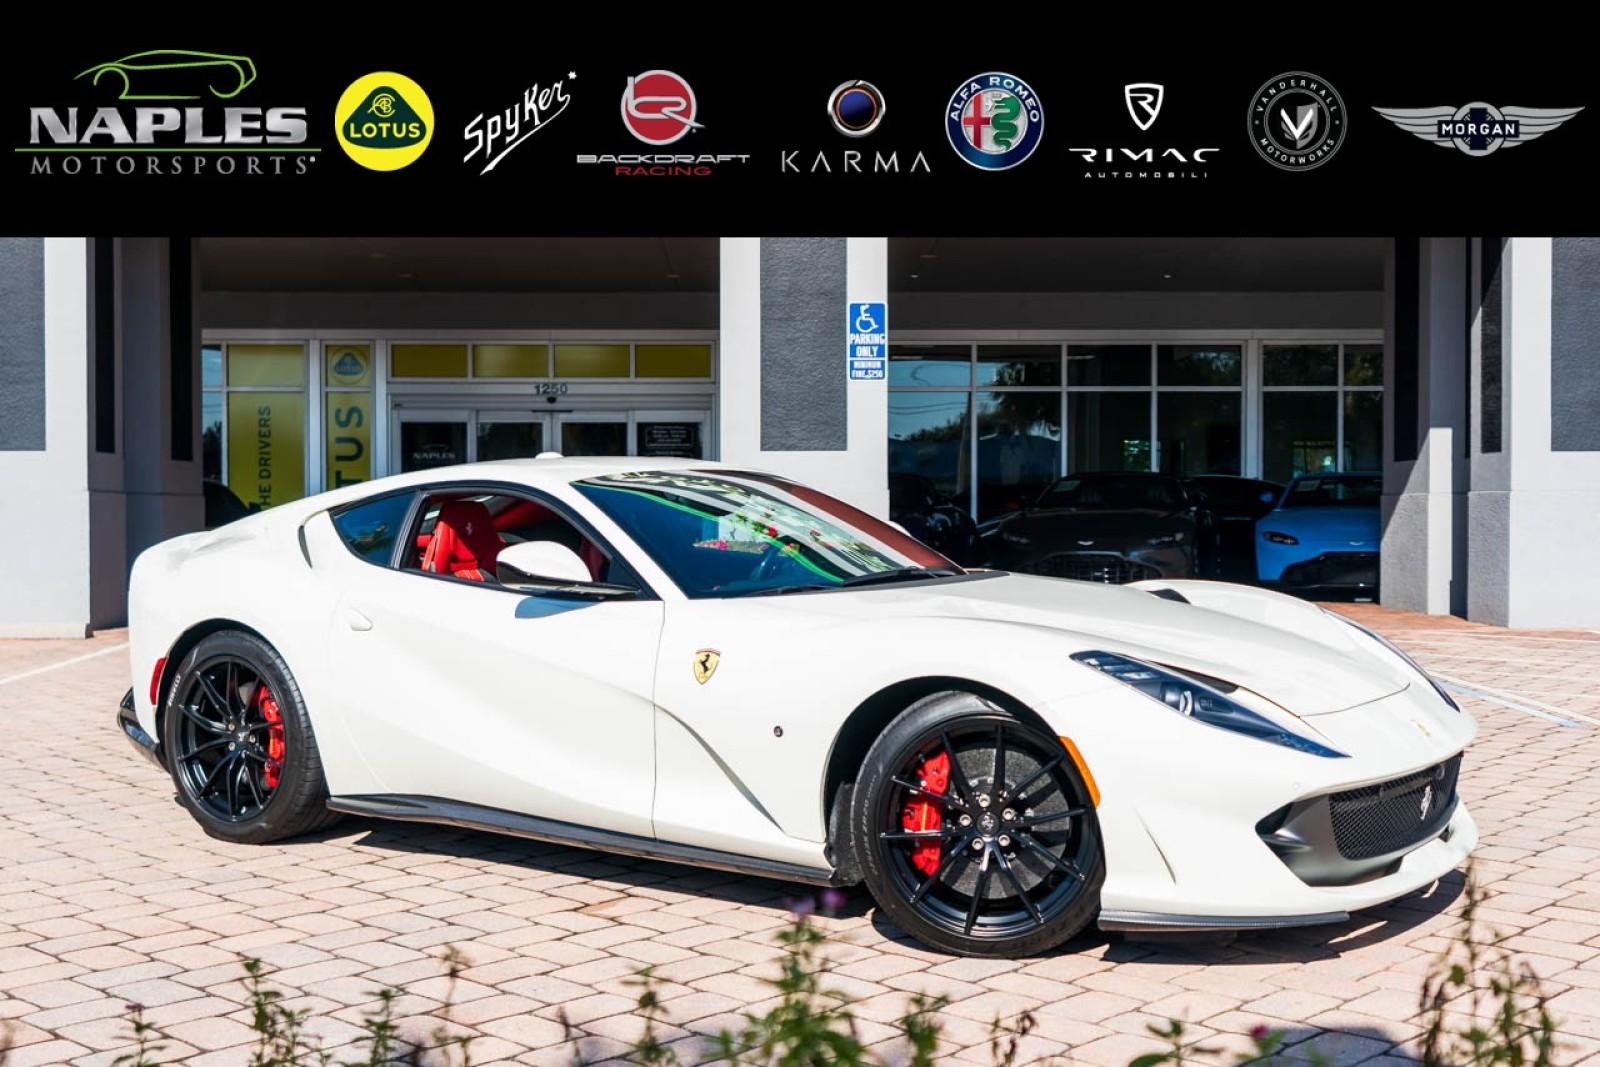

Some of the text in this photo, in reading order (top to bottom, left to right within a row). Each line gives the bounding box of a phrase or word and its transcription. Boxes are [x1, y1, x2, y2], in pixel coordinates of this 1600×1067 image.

[849, 333, 887, 345] PARKING
[856, 345, 879, 357] ONLY
[534, 383, 569, 395] 1250
[258, 405, 272, 479] DRIVERS
[335, 405, 364, 489] TUS
